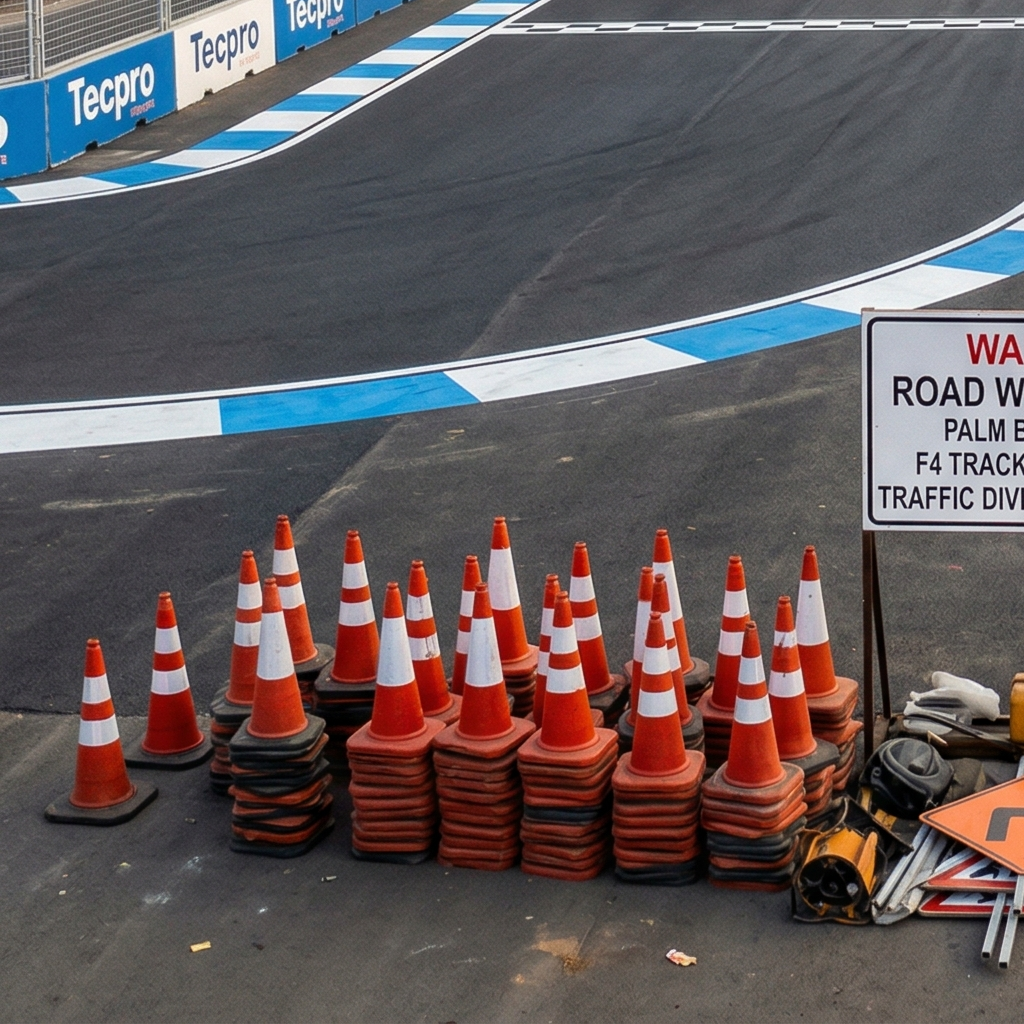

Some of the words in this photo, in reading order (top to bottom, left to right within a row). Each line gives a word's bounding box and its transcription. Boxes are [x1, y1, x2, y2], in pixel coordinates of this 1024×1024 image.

[190, 19, 260, 73] Tecpro
[67, 62, 156, 126] Tecpro
[893, 375, 985, 407] ROAD
[945, 418, 1006, 443] PALM
[916, 451, 942, 476] F4
[877, 485, 974, 510] TRAFFIC
